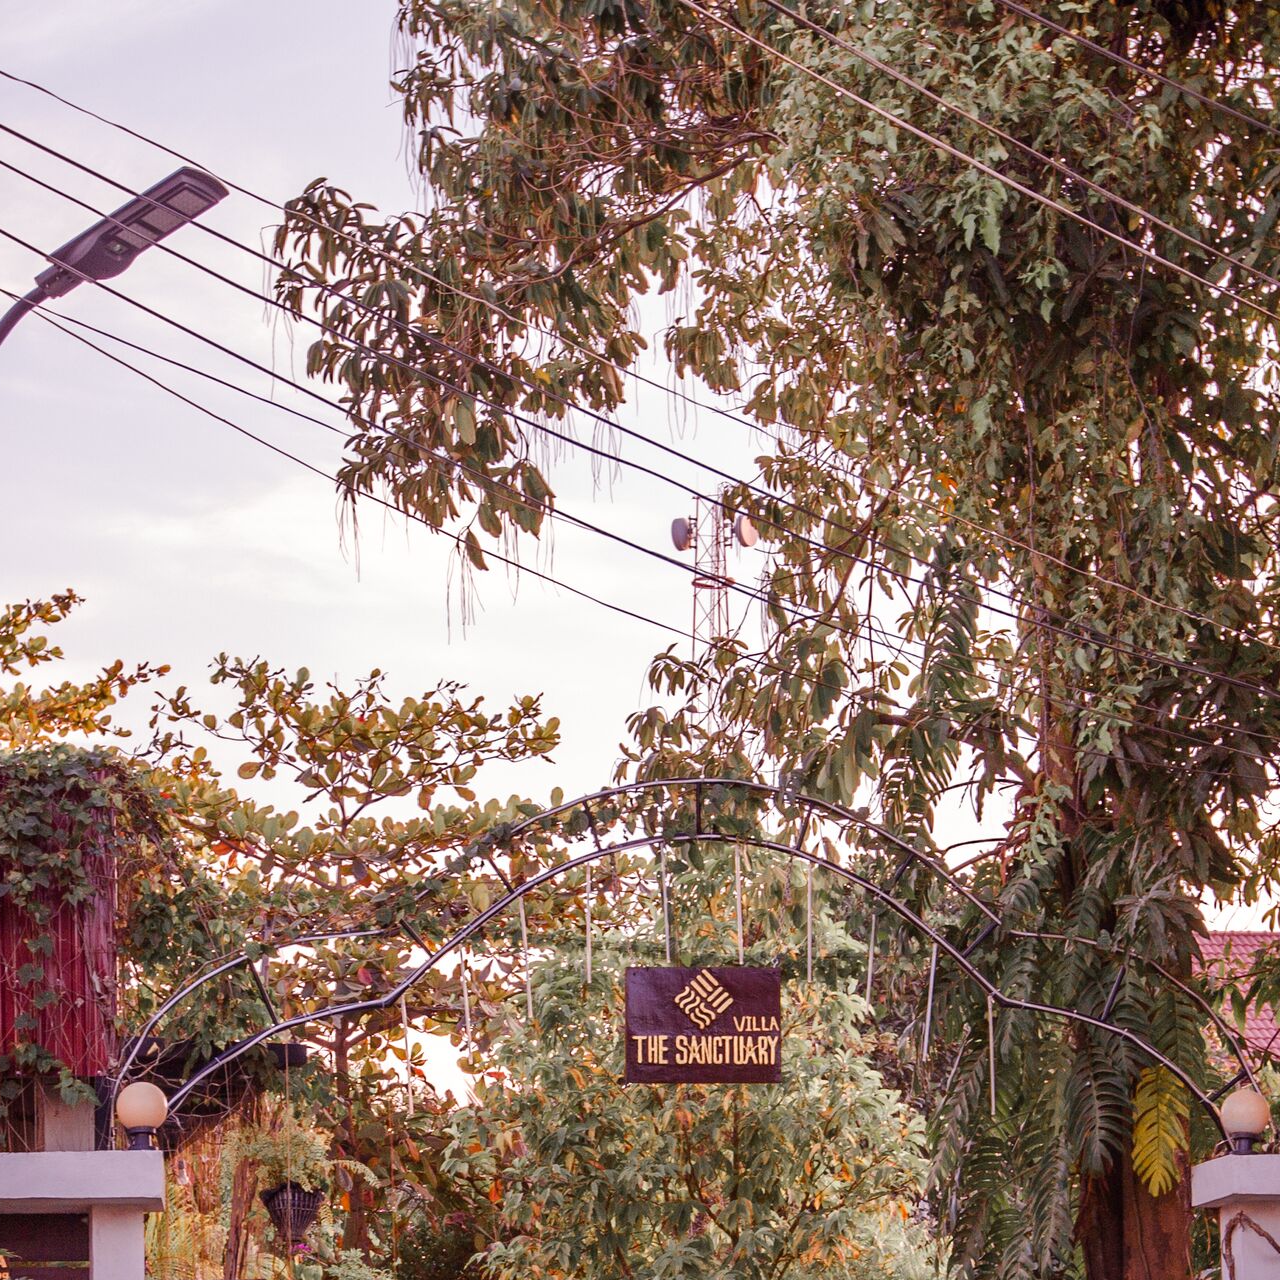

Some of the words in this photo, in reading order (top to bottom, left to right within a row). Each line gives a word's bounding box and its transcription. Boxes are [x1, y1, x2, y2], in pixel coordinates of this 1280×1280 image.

[733, 1015, 780, 1032] VILLA
[632, 1034, 669, 1065] THE
[675, 1034, 779, 1065] SANCTUARY
